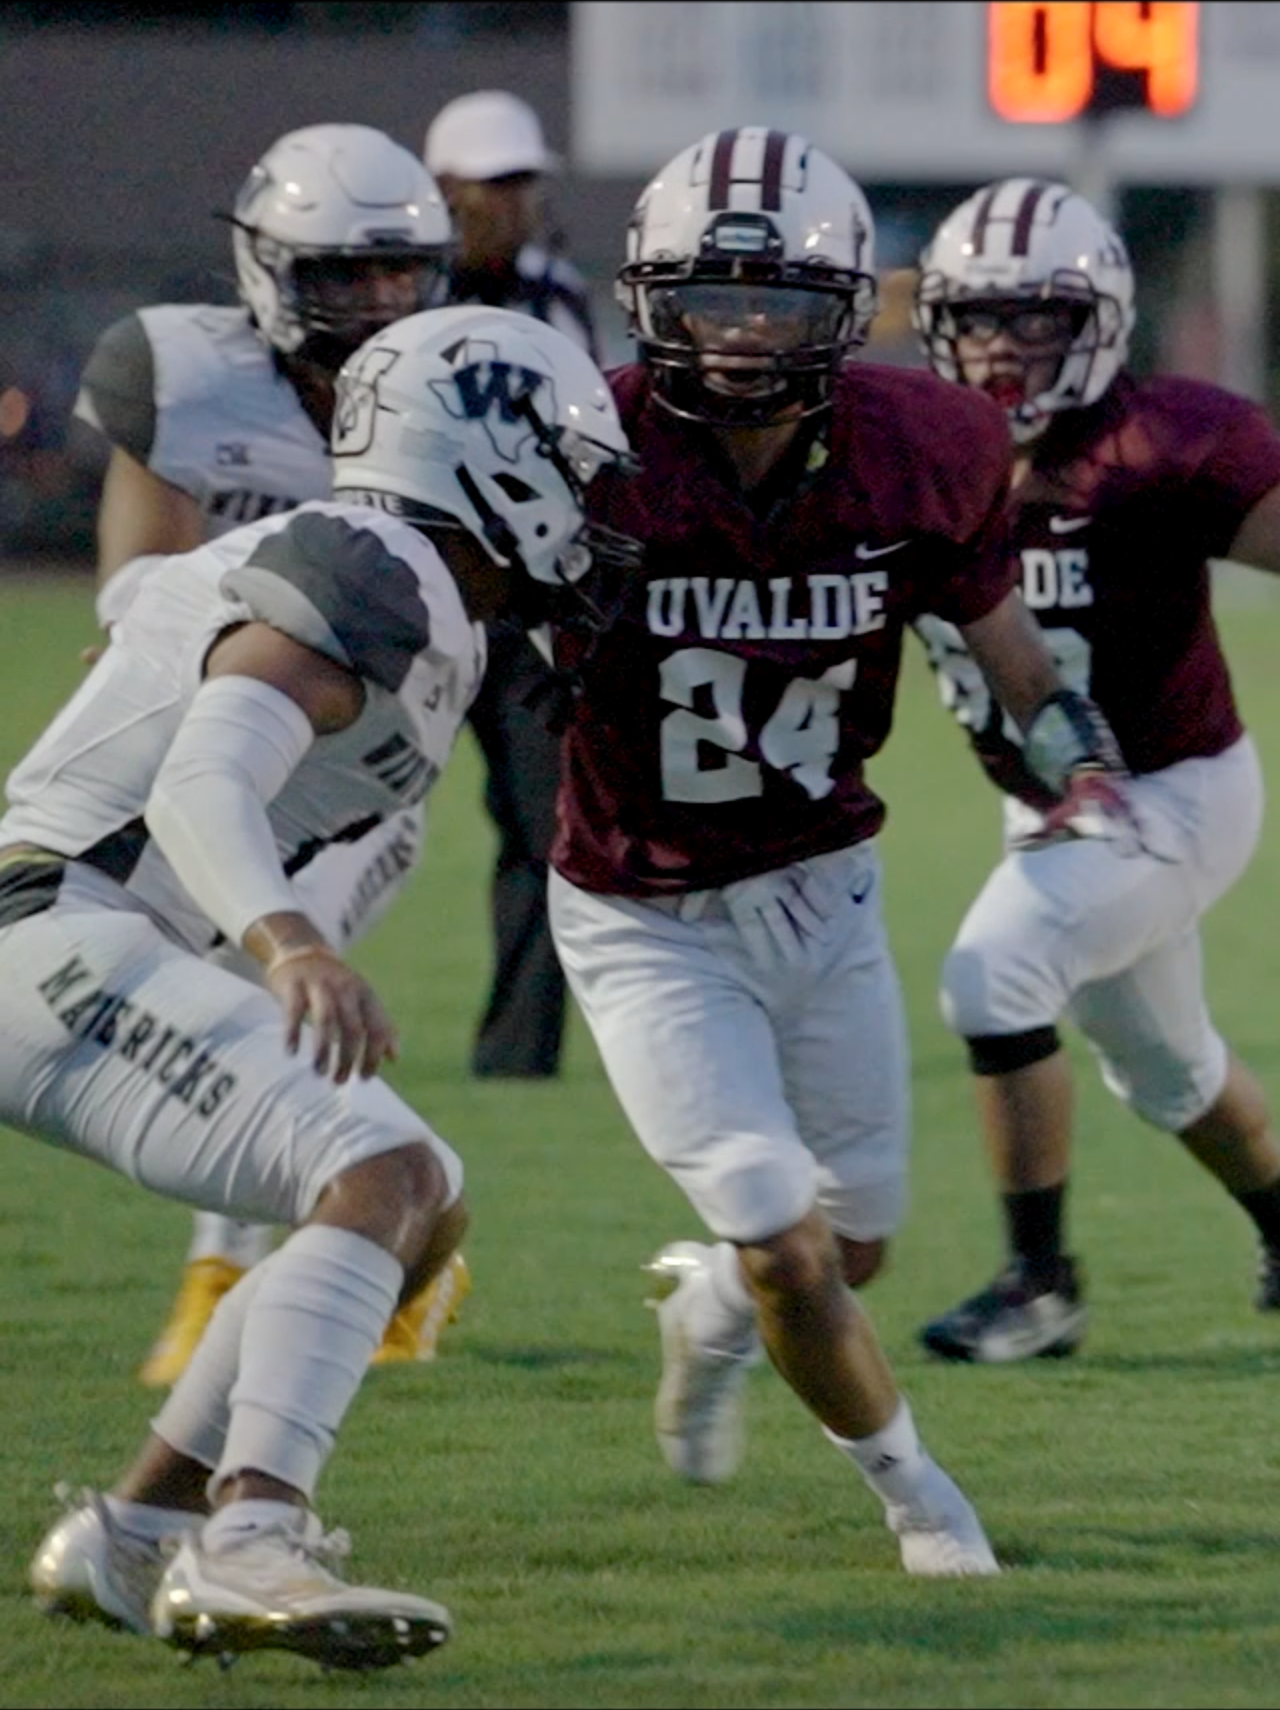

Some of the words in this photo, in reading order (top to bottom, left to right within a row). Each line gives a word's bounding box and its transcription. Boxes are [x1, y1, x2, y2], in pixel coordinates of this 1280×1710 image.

[452, 360, 546, 424] W
[647, 571, 889, 640] UVALDE
[658, 646, 859, 804] 24
